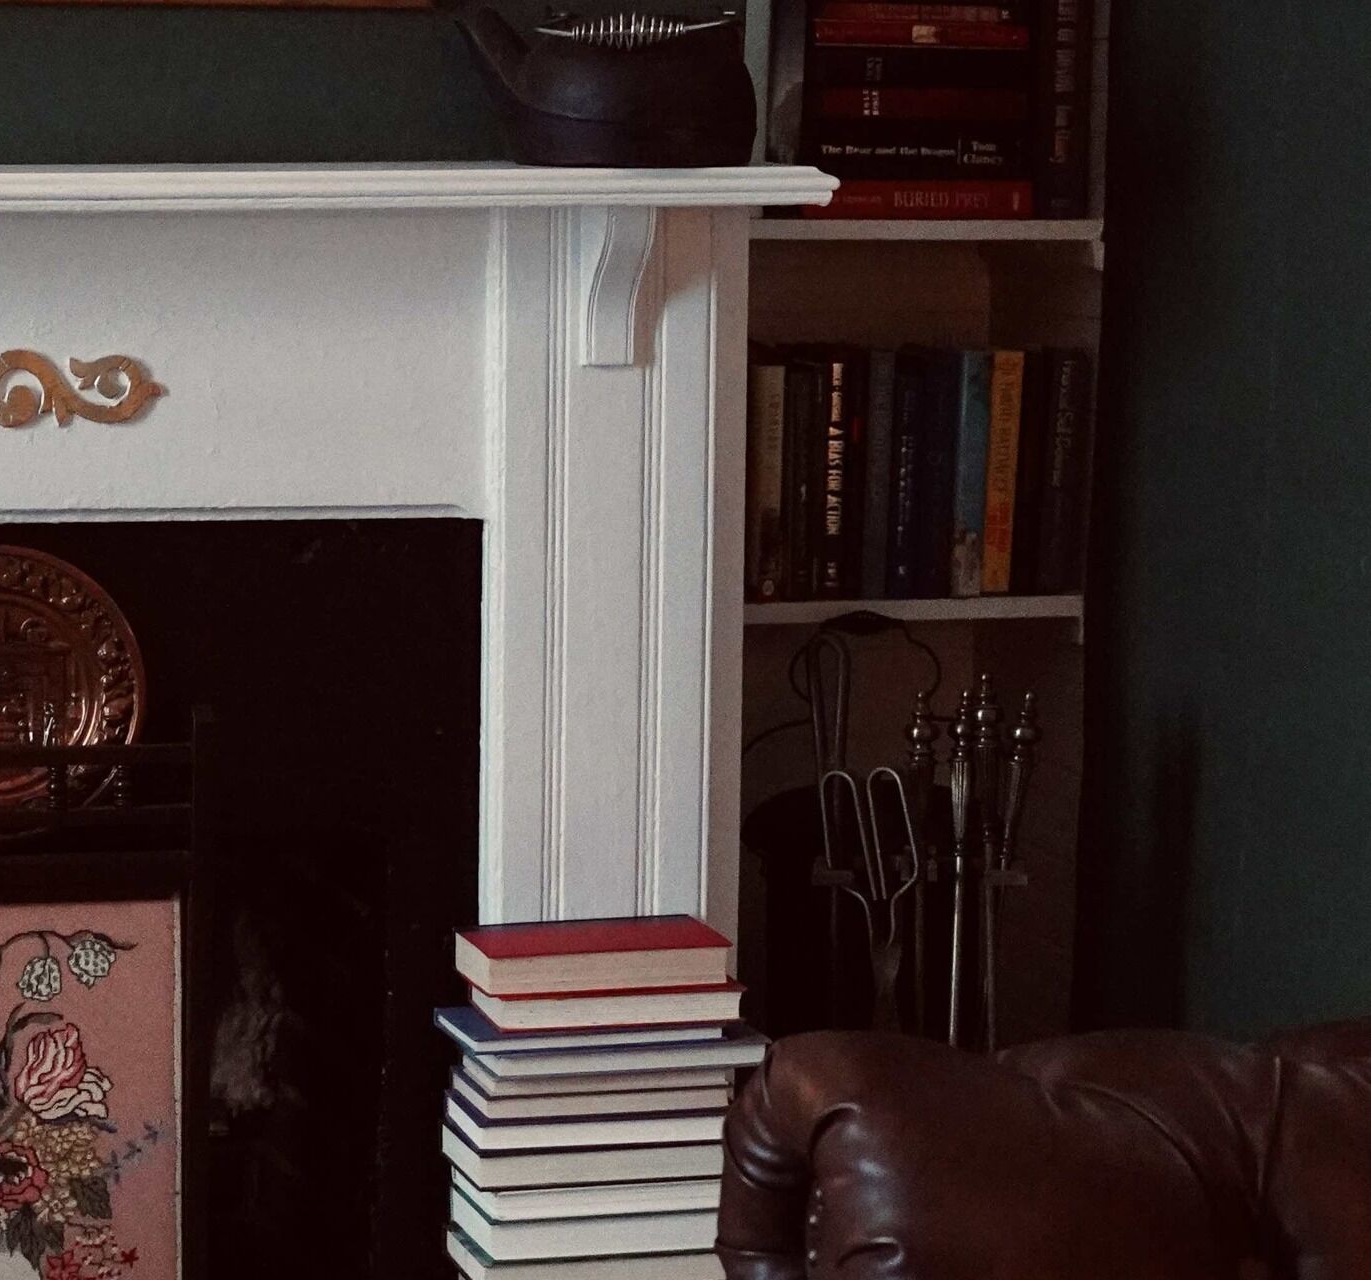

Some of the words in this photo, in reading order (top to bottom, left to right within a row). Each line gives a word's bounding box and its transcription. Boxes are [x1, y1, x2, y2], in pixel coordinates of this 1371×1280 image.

[820, 143, 843, 156] The
[873, 144, 897, 156] and
[898, 145, 918, 156] the
[970, 140, 997, 153] Tom
[962, 152, 1005, 166] Clancy
[893, 190, 949, 209] BURIED
[952, 191, 990, 210] PREY
[827, 425, 845, 437] A
[827, 438, 846, 467] BIAS
[826, 468, 845, 492] FOR
[825, 493, 843, 536] ACTION
